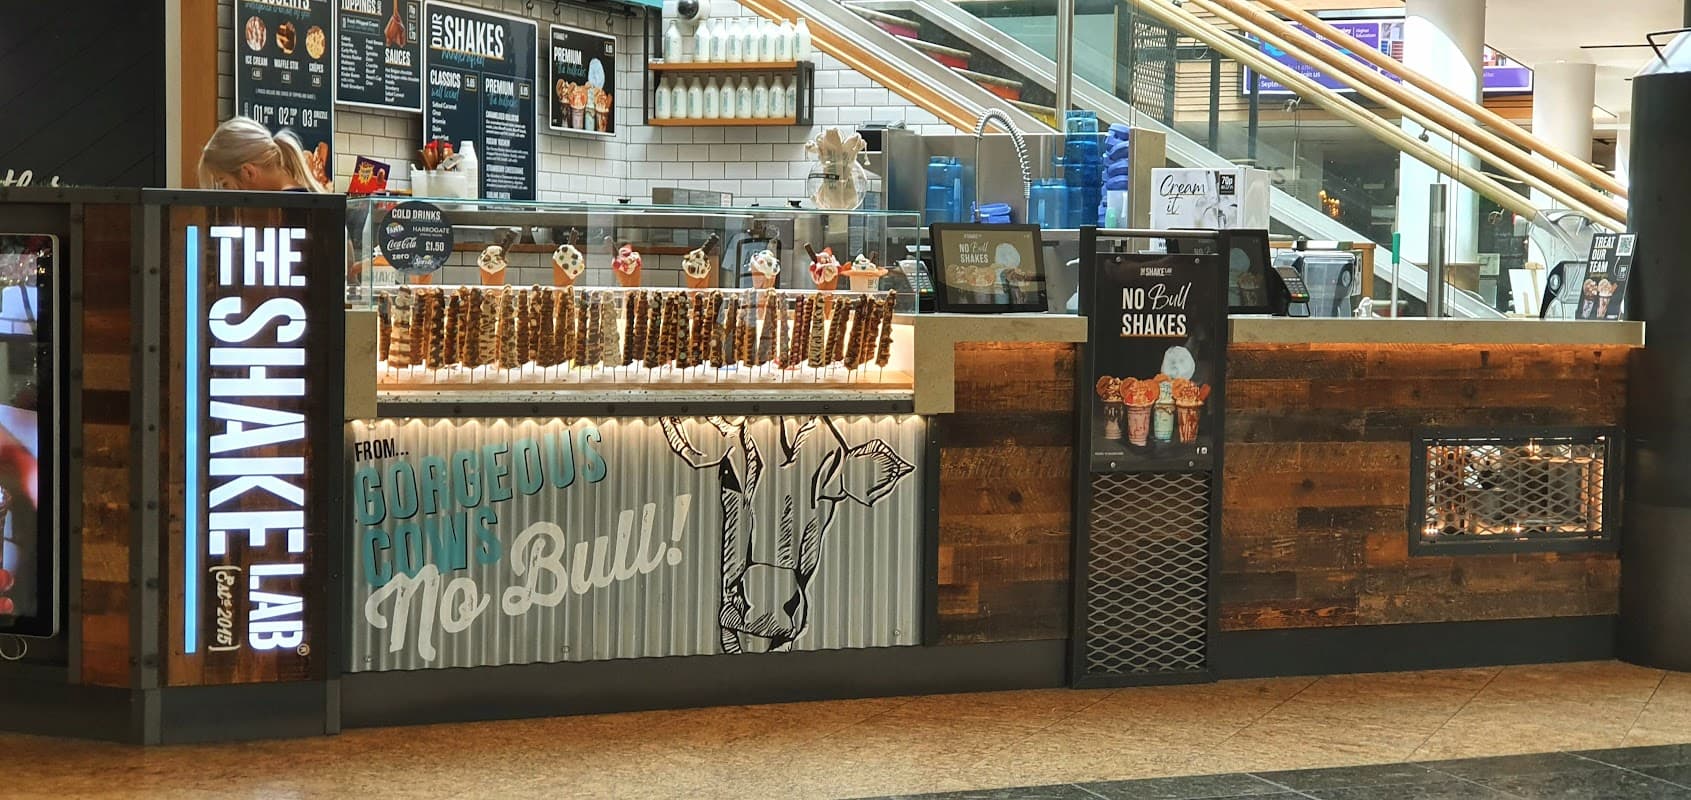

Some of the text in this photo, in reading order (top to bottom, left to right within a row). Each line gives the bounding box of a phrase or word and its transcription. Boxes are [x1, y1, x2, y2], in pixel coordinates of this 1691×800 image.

[432, 13, 442, 47] OUR
[444, 15, 504, 57] SHAKES
[253, 57, 268, 67] CREAM
[385, 47, 411, 66] SAUCES
[554, 46, 582, 65] PREMIUM
[430, 69, 461, 88] CLASSICS
[485, 78, 514, 97] PREMIUM
[279, 107, 289, 125] 02
[302, 109, 313, 127] 03
[1159, 174, 1206, 197] Cream
[1166, 194, 1184, 215] it
[392, 209, 441, 220] COLD DRINKS
[412, 226, 449, 234] HARROGATE
[425, 241, 445, 252] £1.50
[959, 243, 970, 253] NO
[1594, 236, 1616, 249] TREAT
[209, 226, 306, 286] THE
[960, 253, 989, 264] SHAKES
[1591, 249, 1607, 261] OUR
[1146, 267, 1165, 277] SHAKE
[1589, 261, 1609, 273] TEAM
[1122, 282, 1192, 310] NO Bull
[1121, 313, 1186, 336] SHAKES
[208, 296, 306, 556] SHAKE
[355, 438, 409, 462] FROM...
[354, 427, 607, 526] GORGEOUS
[362, 506, 502, 589] COWS
[365, 494, 692, 662] No Bull!
